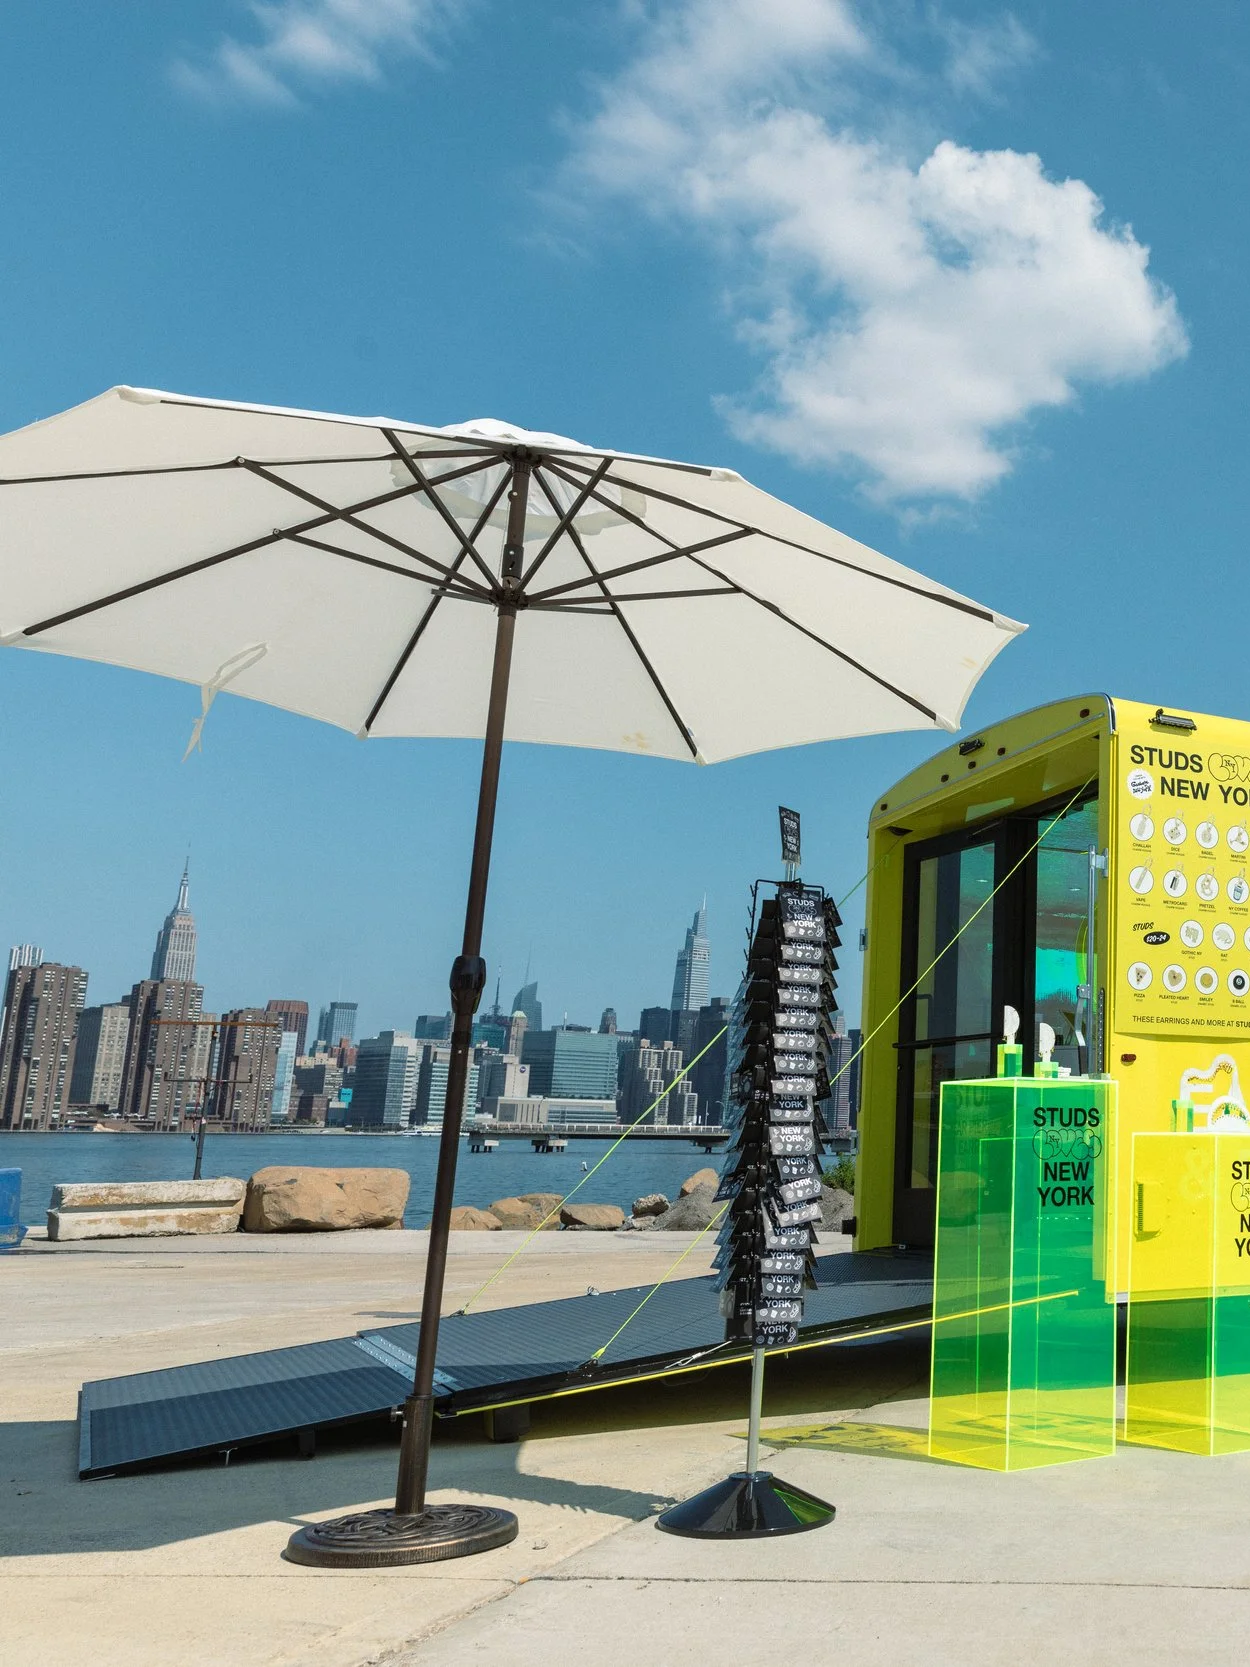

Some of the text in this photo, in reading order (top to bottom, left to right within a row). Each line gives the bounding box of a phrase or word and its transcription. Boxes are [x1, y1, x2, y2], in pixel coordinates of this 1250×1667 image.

[1130, 744, 1203, 773] STUDS
[1160, 776, 1210, 801] NEW
[788, 898, 815, 906] STUDS
[792, 920, 816, 928] YORK
[1132, 922, 1154, 931] STUDS
[790, 942, 814, 950] YORK
[788, 986, 811, 994] YORK
[785, 1008, 809, 1016] YORK
[1156, 1017, 1190, 1025] EARRINGS
[783, 1030, 807, 1038] YORK
[781, 1075, 806, 1083] YORK
[1033, 1107, 1100, 1127] STUDS
[1043, 1162, 1090, 1182] NEW
[788, 1178, 813, 1189] YORK
[1037, 1186, 1095, 1206] YORK
[784, 1201, 809, 1212] YORK
[775, 1227, 800, 1235] YORK
[770, 1252, 795, 1260] YORK
[766, 1300, 792, 1308] YORK
[762, 1325, 788, 1334] YORK
